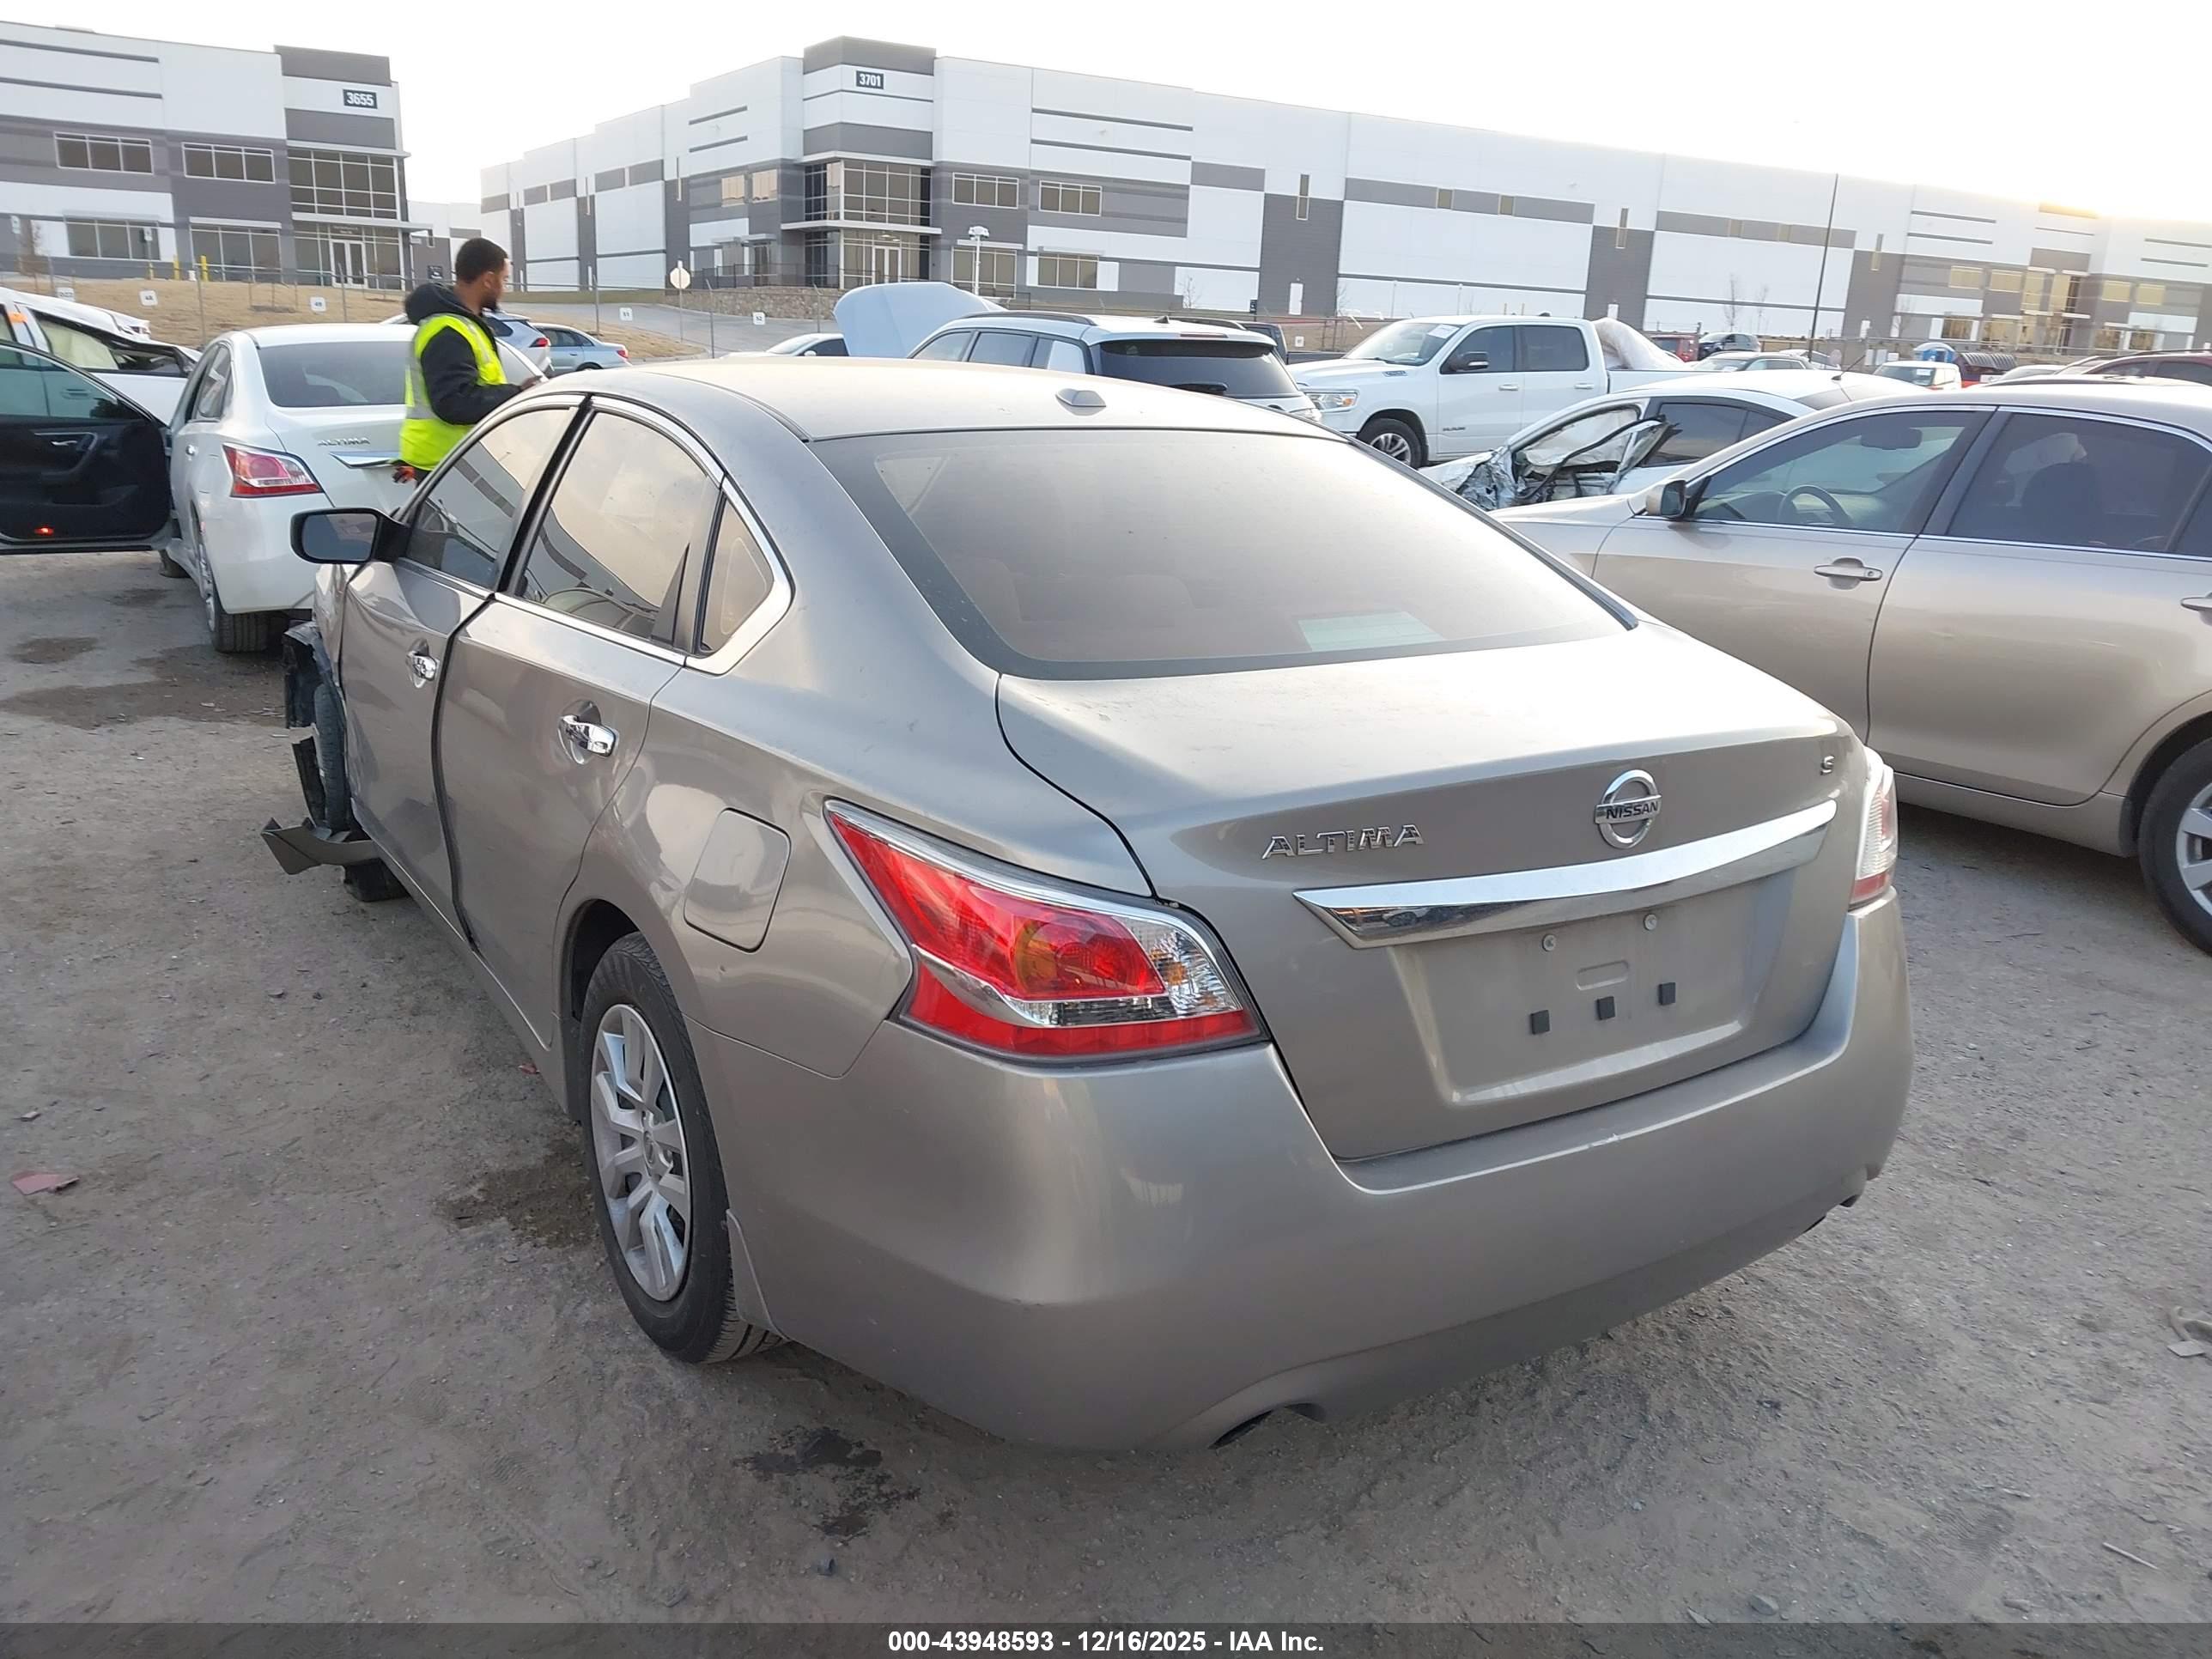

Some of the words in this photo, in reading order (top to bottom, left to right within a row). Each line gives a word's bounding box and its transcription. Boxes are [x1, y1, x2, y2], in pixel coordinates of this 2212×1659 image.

[860, 73, 881, 87] 3701
[346, 92, 374, 106] 3655
[1820, 756, 1835, 775] S
[1606, 800, 1660, 820] NISSAN
[1261, 823, 1425, 860] ALTIMA
